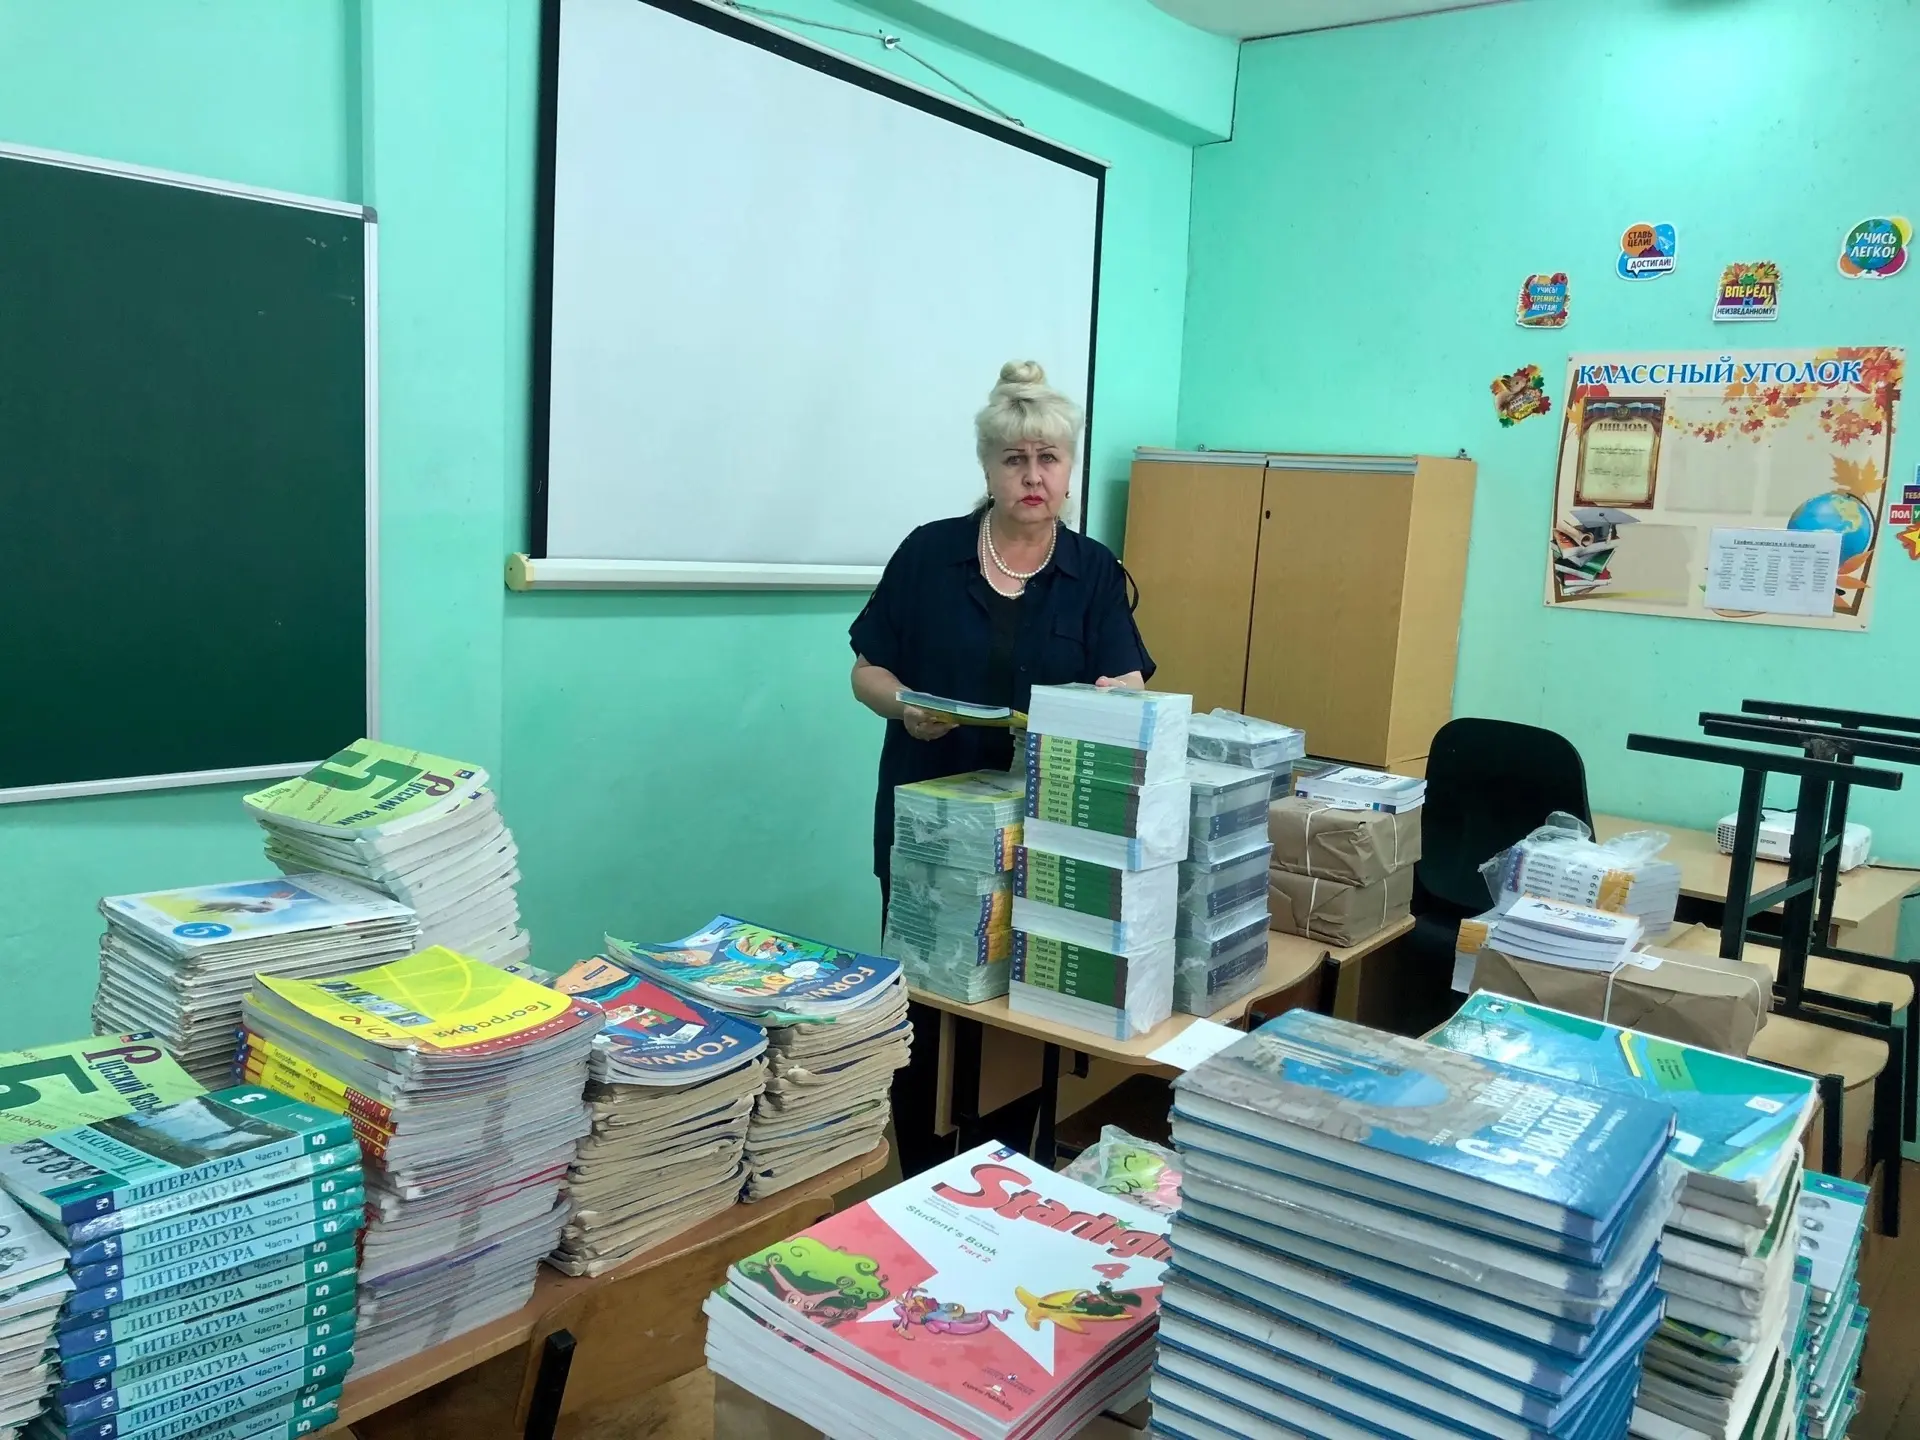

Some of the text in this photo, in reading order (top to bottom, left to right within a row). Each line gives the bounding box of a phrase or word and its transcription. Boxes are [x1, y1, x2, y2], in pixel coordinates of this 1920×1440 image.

[1627, 239, 1652, 247] ЦЕЛИ!
[1628, 231, 1653, 240] СТАВЬ
[1855, 233, 1897, 245] УЧИСЬ
[1630, 258, 1672, 269] ДОСТИГАЙ!
[1850, 247, 1896, 258] ЛЕГКО!
[1536, 286, 1559, 294] УЧИСЬ!
[1725, 284, 1772, 299] ВПЕРЁД!
[1531, 303, 1557, 312] МЕЧТАЙ!
[1716, 307, 1776, 315] НЕИЗВЕДАННОМУ!
[1578, 356, 1863, 385] КЛАССНЫЙ УГОЛОК
[1595, 423, 1648, 432] ДИПЛОМ
[1891, 510, 1911, 519] ПОЛ
[374, 771, 455, 811] Русский
[334, 809, 377, 825] язык
[433, 1000, 551, 1038] География
[82, 1046, 162, 1095] Русский
[126, 1092, 163, 1113] язы
[1520, 1095, 1602, 1160] ИСТОРИЯ
[125, 1157, 246, 1203] ЛИТЕРАТУРА
[255, 1150, 282, 1161] Часть
[312, 1134, 326, 1146] 5
[320, 1152, 335, 1165] 5
[133, 1204, 254, 1248] ЛИТЕРАТУРА
[263, 1197, 291, 1208] Часть
[321, 1180, 335, 1192] 5
[135, 1224, 255, 1270] ЛИТЕРАТУРА
[265, 1216, 293, 1228] Часть
[323, 1198, 337, 1211] 5
[905, 1205, 964, 1238] Student's
[965, 1236, 998, 1256] Book
[134, 1245, 255, 1292] ЛИТЕРАТУРА
[265, 1237, 293, 1249] Часть
[323, 1220, 337, 1233] 5
[313, 1241, 327, 1253] 5
[958, 1244, 982, 1259] Part
[1091, 1262, 1131, 1280] 4
[123, 1287, 245, 1335] ЛИТЕРАТУРА
[255, 1280, 283, 1290] Часть
[314, 1261, 328, 1274] 5
[128, 1312, 248, 1360] ЛИТЕРАТУРА
[258, 1304, 285, 1315] Часть
[315, 1284, 330, 1296] 5
[123, 1332, 243, 1381] ЛИТЕРАТУРА
[254, 1324, 282, 1335] Часть
[313, 1304, 327, 1317] 5
[129, 1352, 248, 1401] ЛИТЕРАТУРА
[259, 1343, 286, 1354] Часть
[316, 1323, 330, 1336] 5
[127, 1375, 246, 1428] ЛИТЕРАТУРА
[255, 1365, 282, 1376] Часть
[312, 1344, 327, 1357] 5
[255, 1386, 282, 1397] Часть
[312, 1364, 326, 1377] 5
[246, 1418, 273, 1430] Часть
[302, 1395, 316, 1408] 5
[297, 1420, 311, 1432] 5
